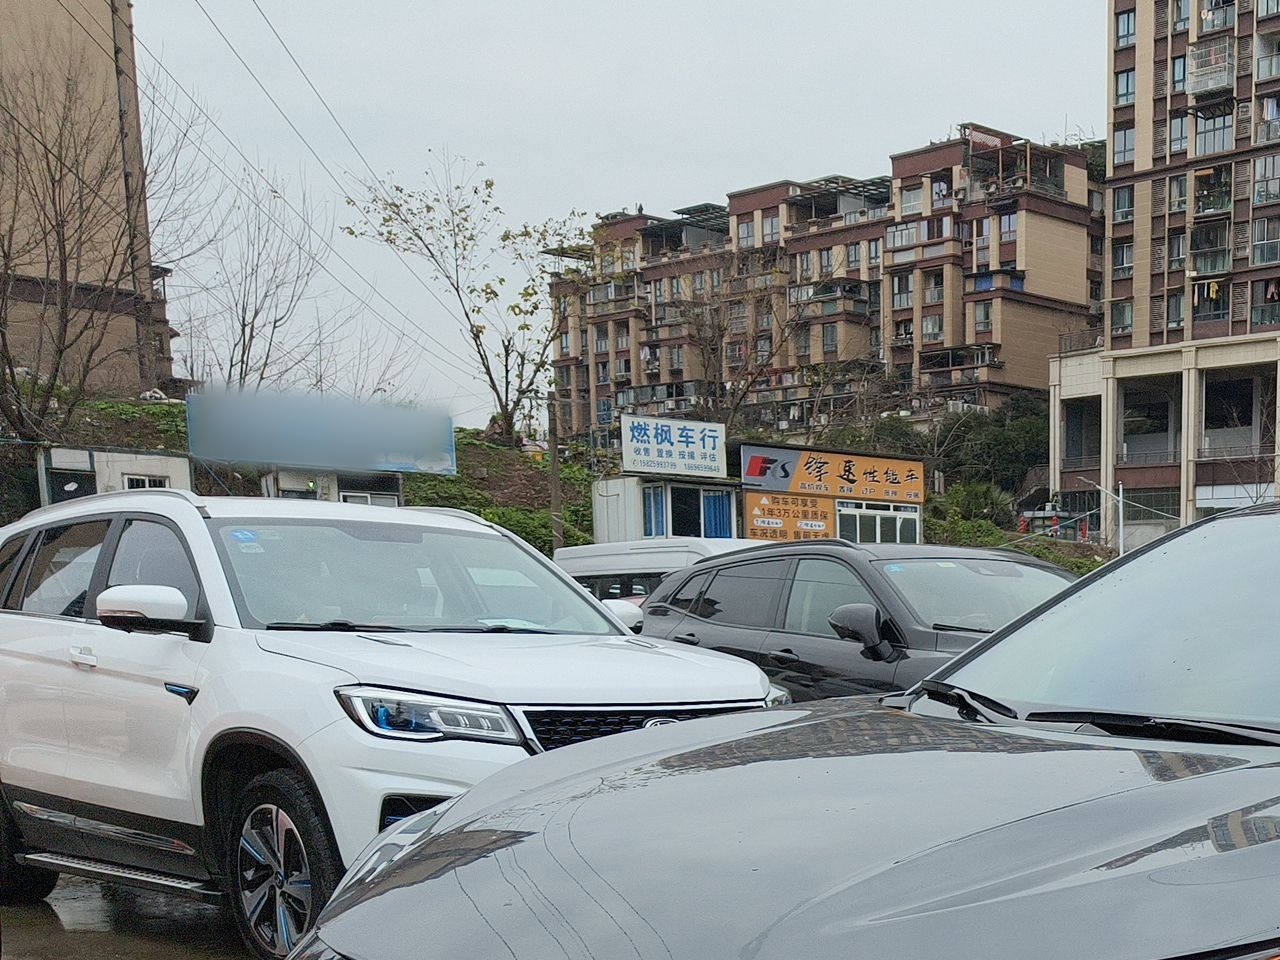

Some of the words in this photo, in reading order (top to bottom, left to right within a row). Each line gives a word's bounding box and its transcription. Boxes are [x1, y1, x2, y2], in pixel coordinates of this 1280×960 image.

[629, 421, 719, 451] 燃枫车行
[656, 448, 674, 459] 置换
[678, 450, 696, 460] 按揭
[700, 452, 717, 462] 评估
[771, 496, 819, 509] 购车可享受
[761, 508, 830, 521] 1年3万公里质保
[749, 528, 788, 539] 车况透明
